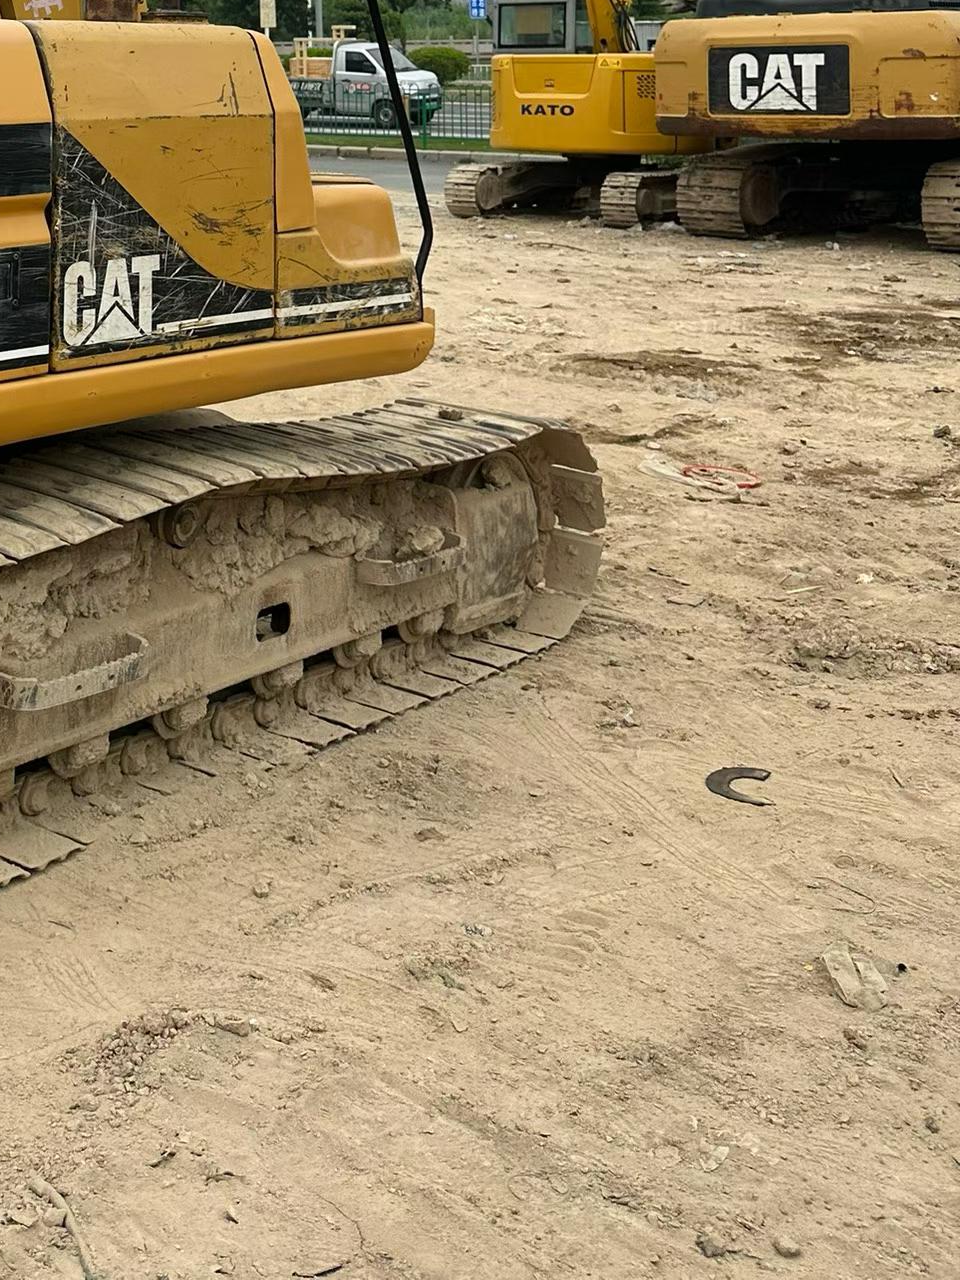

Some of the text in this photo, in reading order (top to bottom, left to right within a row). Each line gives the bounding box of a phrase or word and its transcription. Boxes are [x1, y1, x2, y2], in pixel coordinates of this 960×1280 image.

[521, 104, 575, 116] KATO
[728, 53, 825, 112] CAT
[62, 253, 161, 347] CAT
